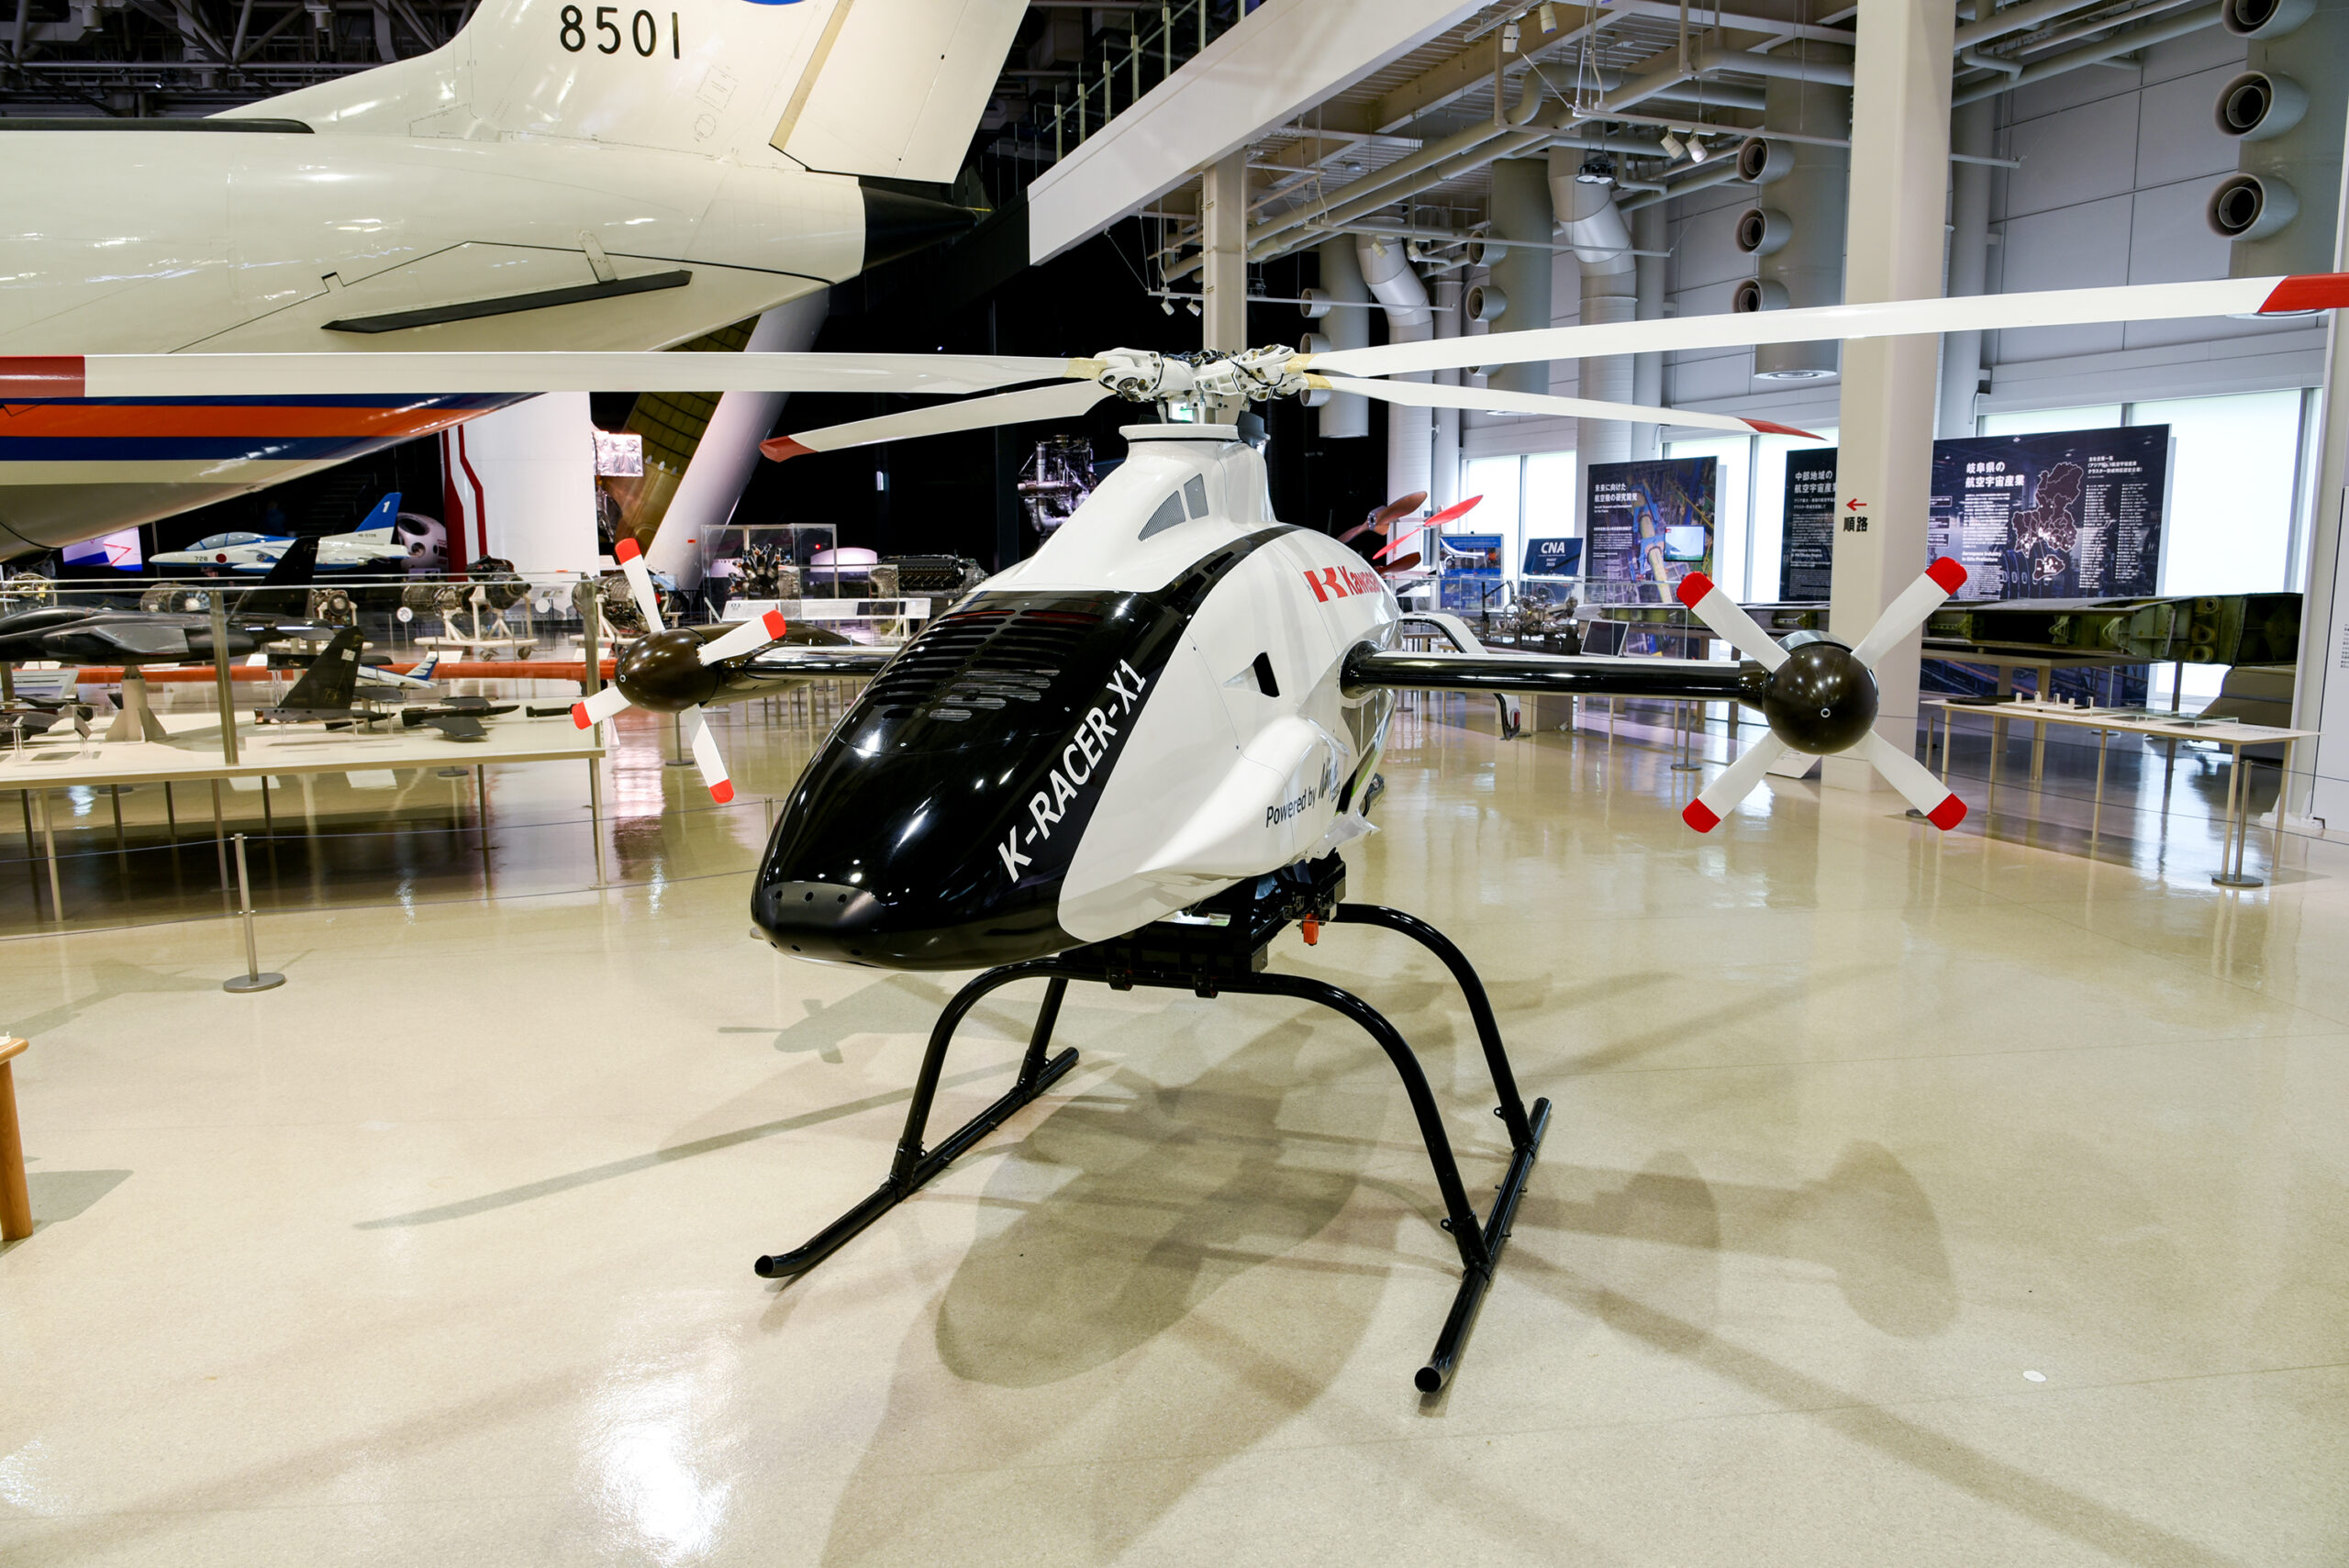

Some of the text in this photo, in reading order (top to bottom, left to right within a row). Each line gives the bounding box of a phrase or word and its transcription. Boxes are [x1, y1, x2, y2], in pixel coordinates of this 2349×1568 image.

[560, 5, 680, 60] 8501
[1966, 462, 2005, 473] 岐阜県の
[1795, 470, 1833, 482] 中部地域の
[1965, 474, 2025, 488] 航空宇宙産業
[1595, 483, 1627, 492] 未来に向けた
[1594, 492, 1638, 503] 航空機の研究開発
[382, 501, 391, 513] 1
[1843, 517, 1868, 532] 順路
[1541, 541, 1565, 554] CNA
[997, 659, 1147, 884] K-RACER-X1
[1265, 786, 1307, 828] Powered
[1308, 785, 1318, 809] by
